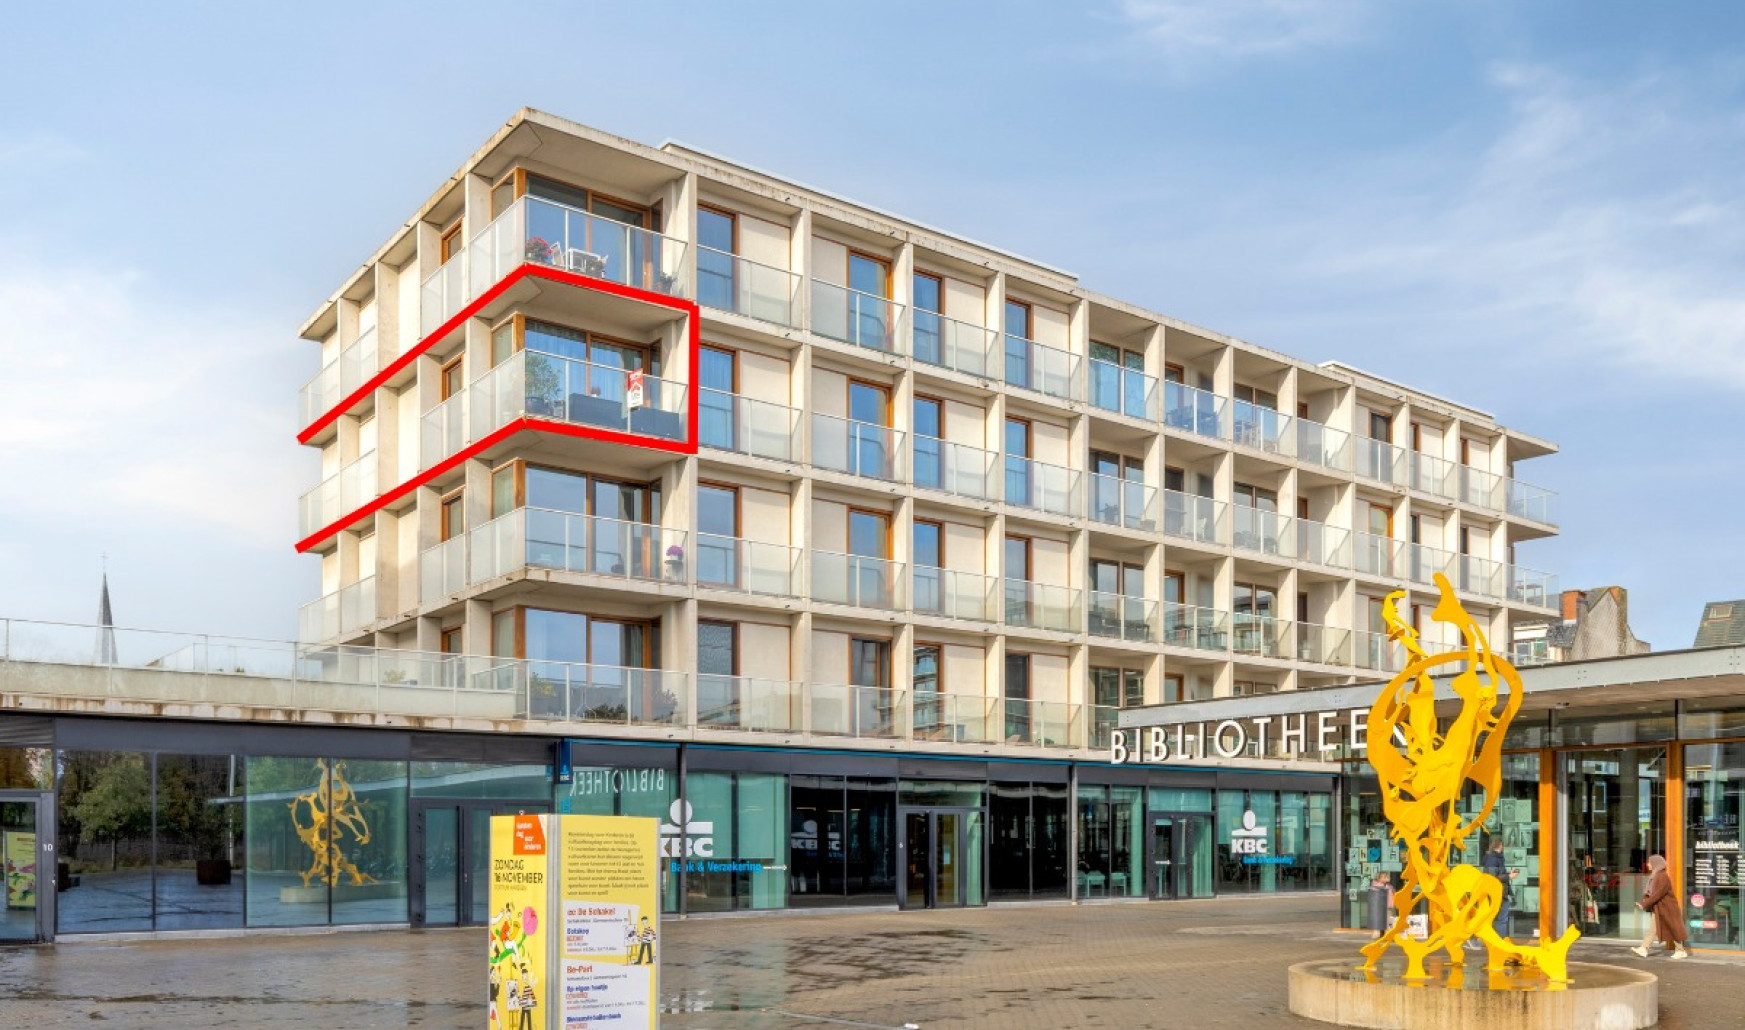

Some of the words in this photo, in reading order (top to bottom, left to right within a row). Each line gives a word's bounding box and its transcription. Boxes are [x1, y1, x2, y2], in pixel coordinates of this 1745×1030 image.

[1111, 709, 1408, 764] BIBLIOTHEE
[43, 843, 53, 852] 10
[1232, 838, 1268, 854] KBC
[708, 861, 763, 874] Verzekering
[502, 872, 543, 884] NOVEMBER
